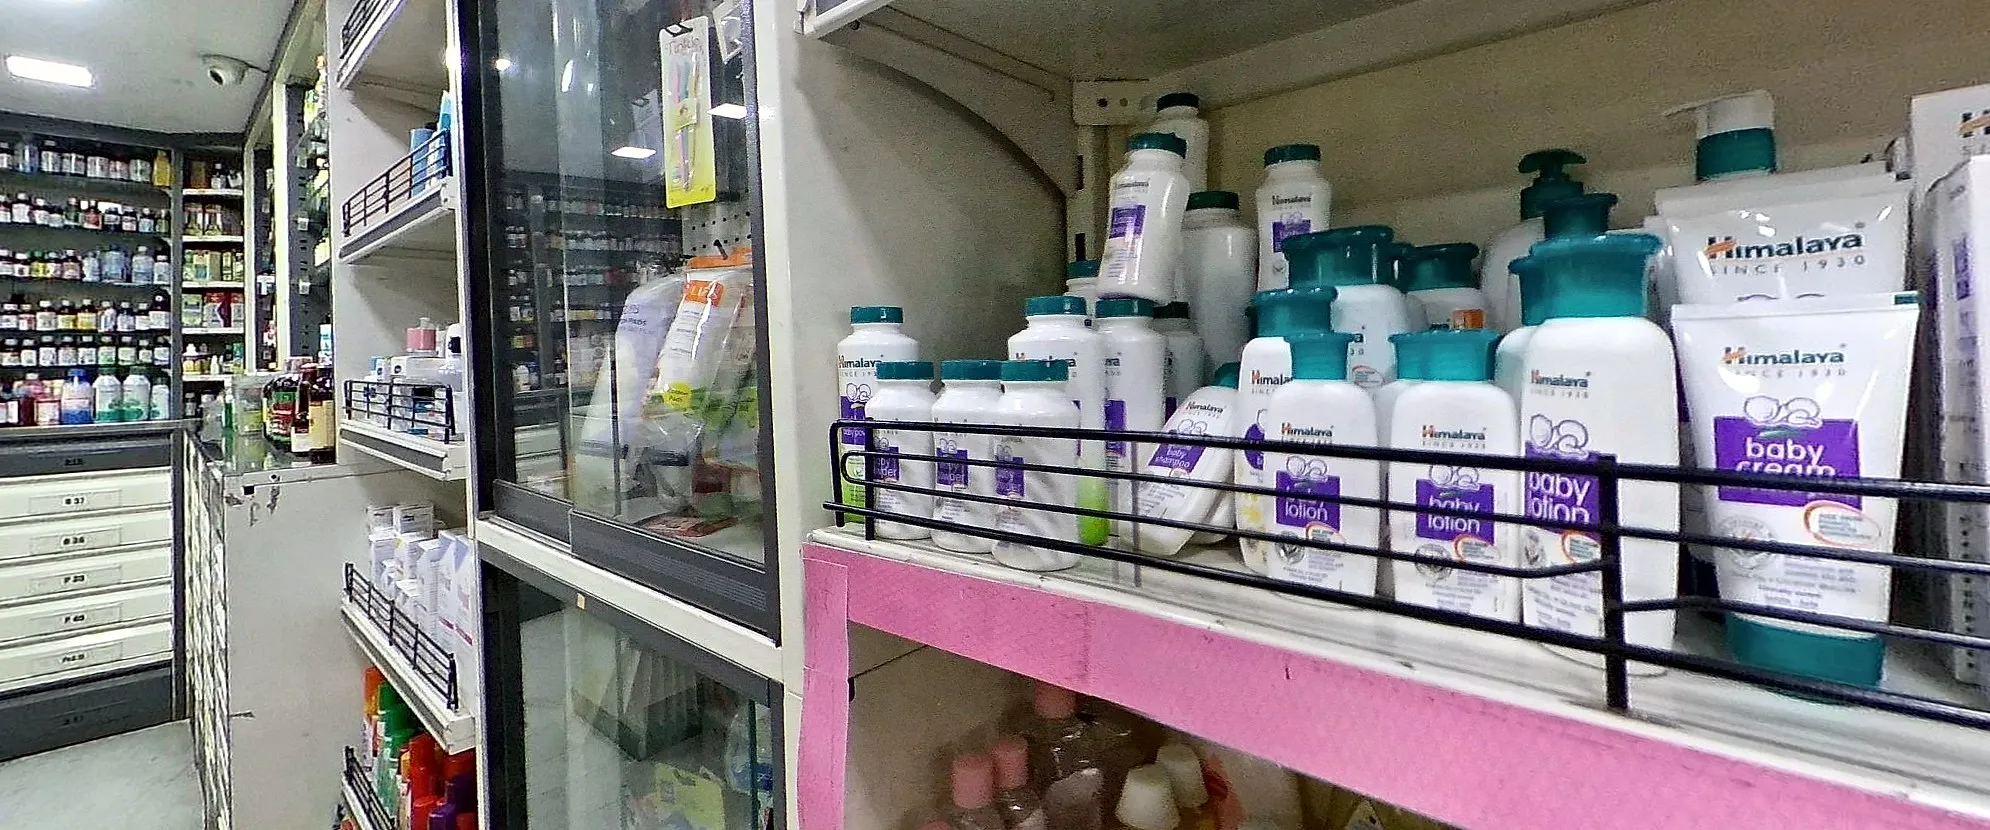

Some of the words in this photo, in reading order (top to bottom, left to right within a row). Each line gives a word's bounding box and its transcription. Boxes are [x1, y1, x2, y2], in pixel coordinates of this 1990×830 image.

[1704, 232, 1864, 260] Himalaya
[1802, 254, 1866, 273] 1930
[838, 355, 882, 369] Himalay
[1724, 346, 1845, 366] Himalaya
[1252, 369, 1293, 386] Himala
[1531, 369, 1589, 388] Himalaya
[1281, 422, 1333, 438] Himalaya
[1422, 424, 1486, 441] Himalaya
[1745, 436, 1825, 469] baby
[1529, 472, 1591, 507] baby
[1285, 499, 1329, 521] lotion
[1428, 514, 1481, 534] lotion
